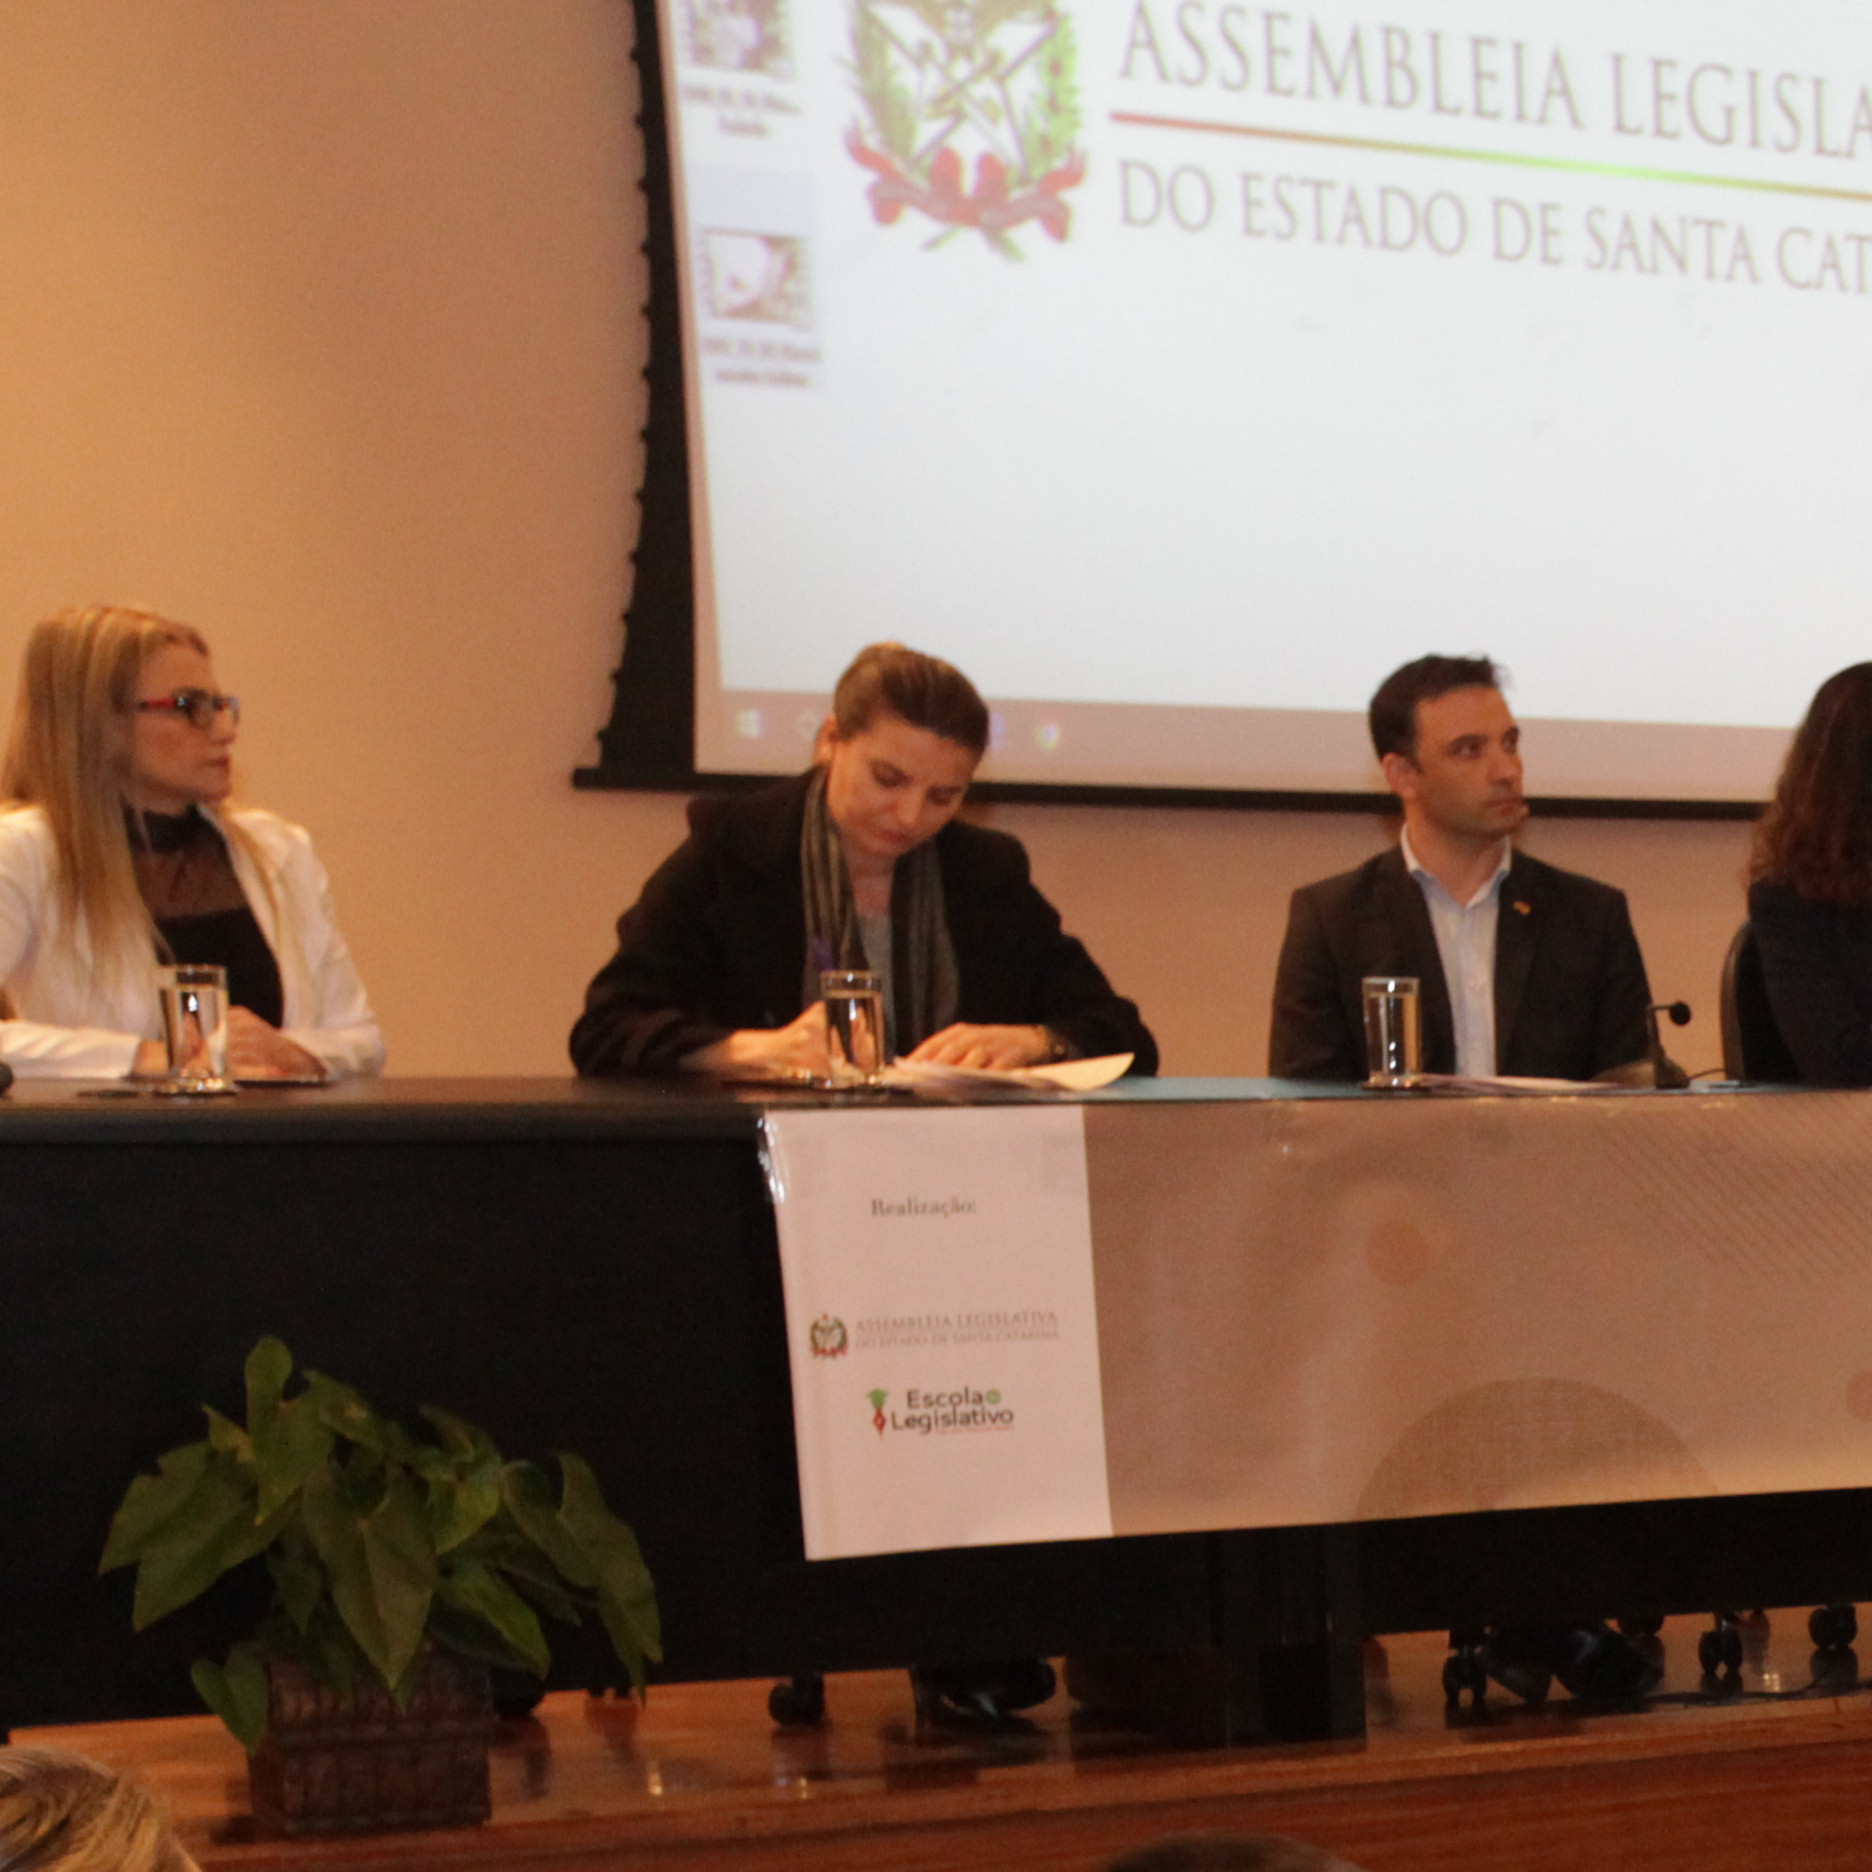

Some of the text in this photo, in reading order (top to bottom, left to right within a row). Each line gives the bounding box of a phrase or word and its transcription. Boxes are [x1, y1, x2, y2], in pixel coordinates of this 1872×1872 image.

[1118, 0, 1587, 131] ASSEMBLEIA
[1118, 158, 1217, 234] DO
[1237, 171, 1470, 258] ESTADO
[1490, 197, 1565, 267] DE
[1583, 205, 1763, 286] SANTA
[890, 1405, 1014, 1435] Legislativo
[906, 1386, 984, 1410] Escola
